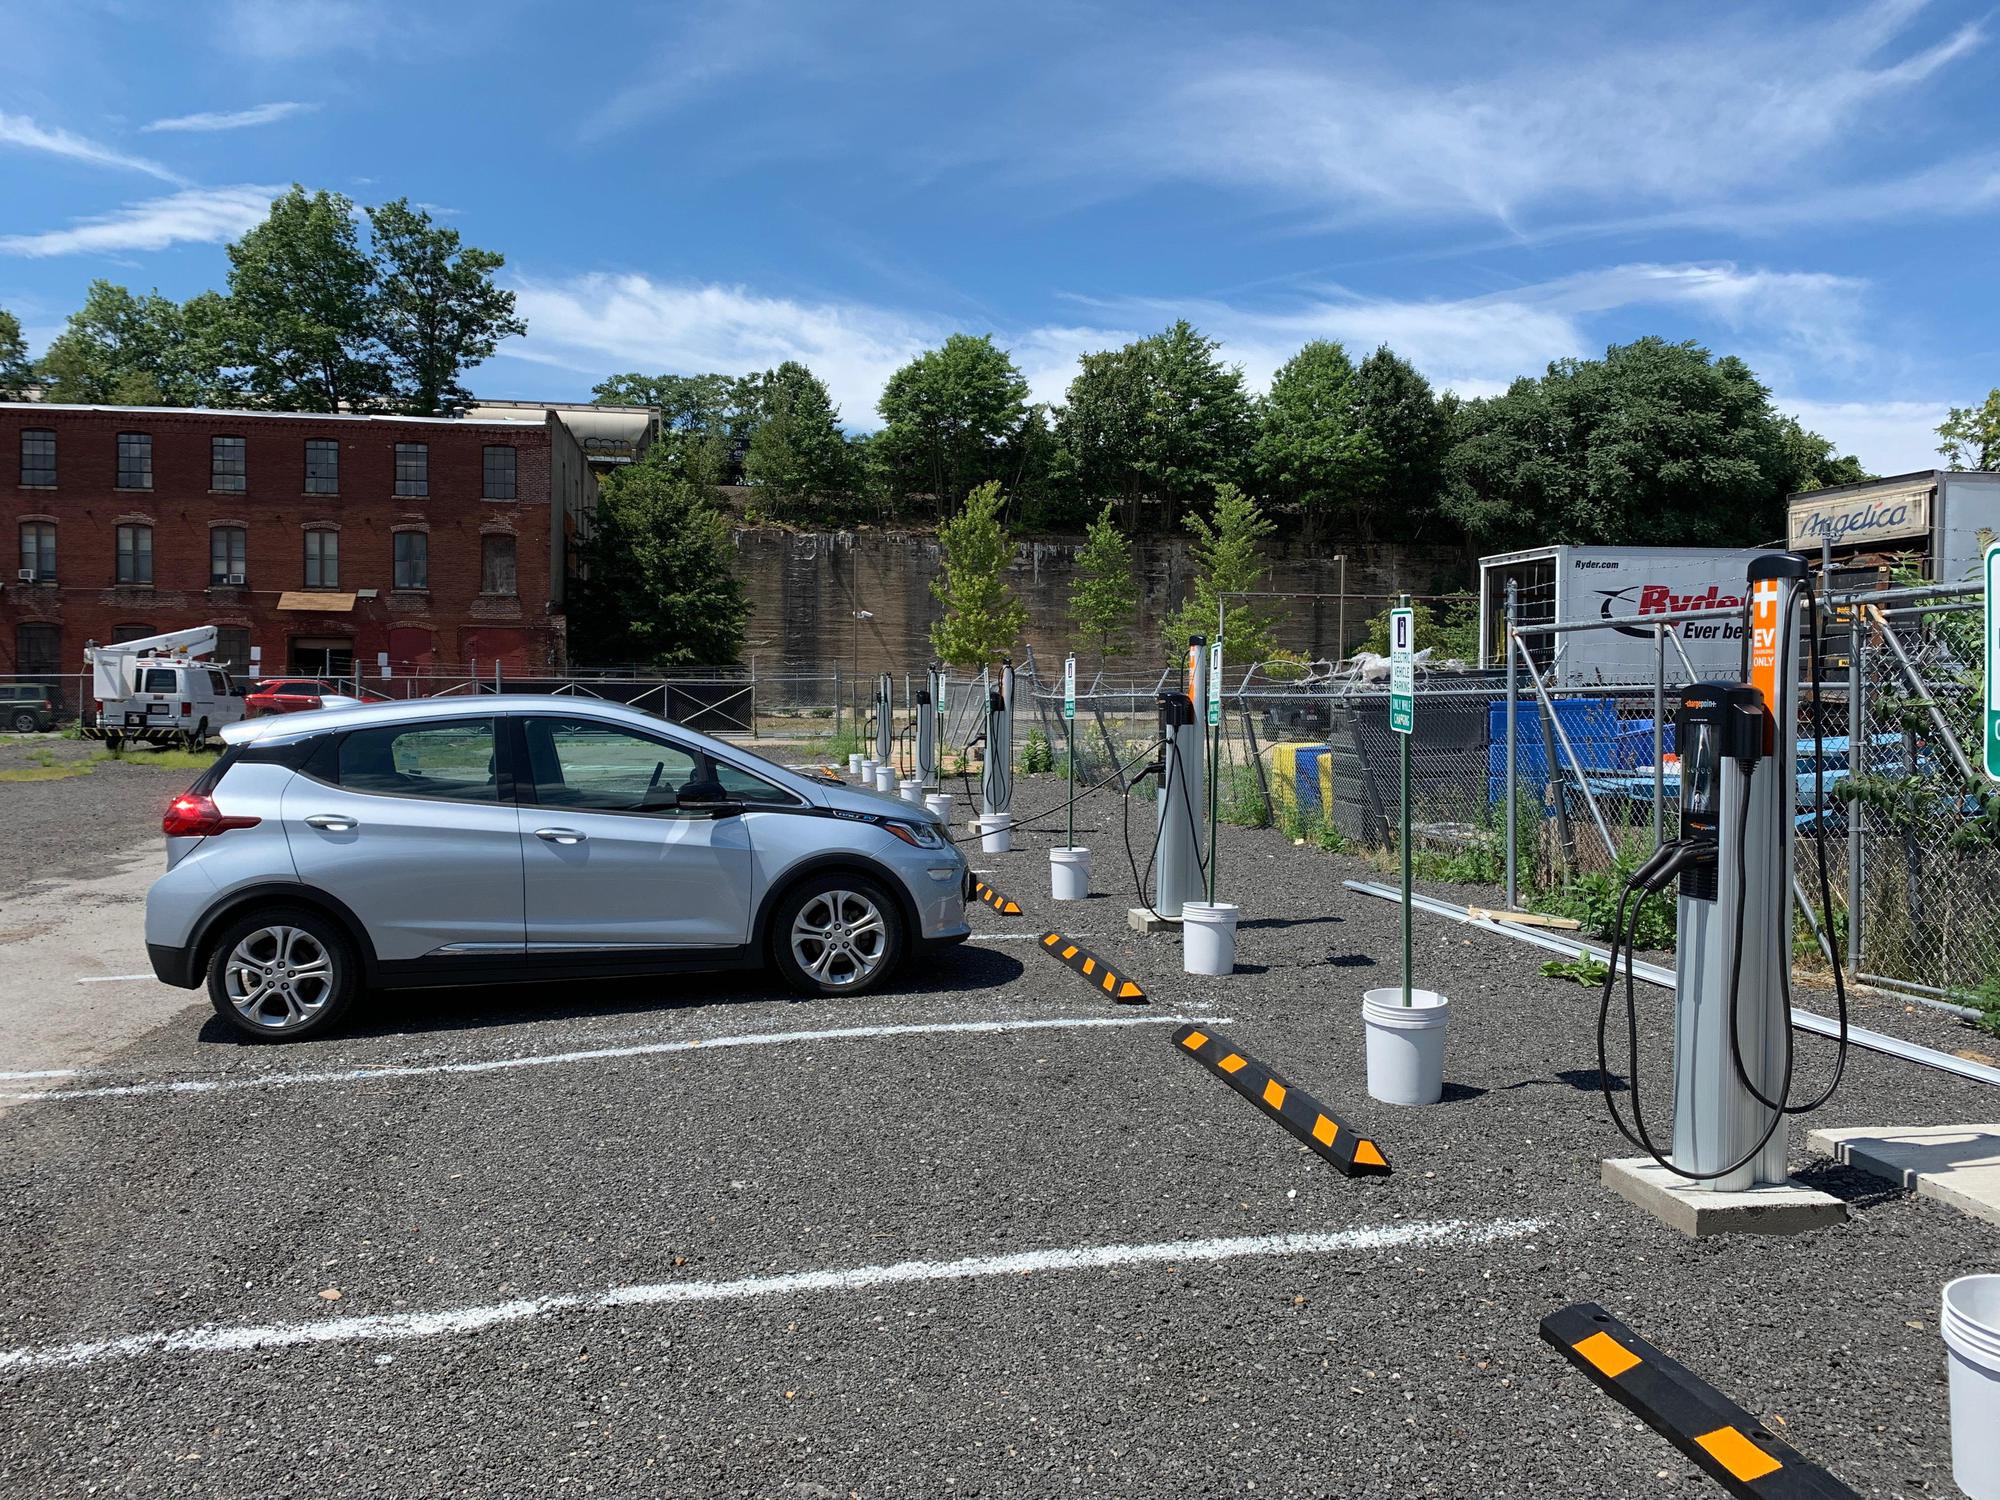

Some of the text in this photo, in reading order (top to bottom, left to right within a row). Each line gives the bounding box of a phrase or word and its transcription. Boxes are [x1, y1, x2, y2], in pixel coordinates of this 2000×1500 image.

[1801, 502, 1908, 542] Angelica
[1575, 560, 1620, 570] Ryder.com
[1683, 622, 1720, 639] Ever
[1754, 628, 1775, 647] EV
[1393, 652, 1411, 664] ELECTRIC
[1753, 657, 1774, 667] ONLY
[1394, 666, 1411, 679] VEHICLE
[1394, 680, 1411, 693] PARKING
[1393, 698, 1411, 712] ONLY WHILE
